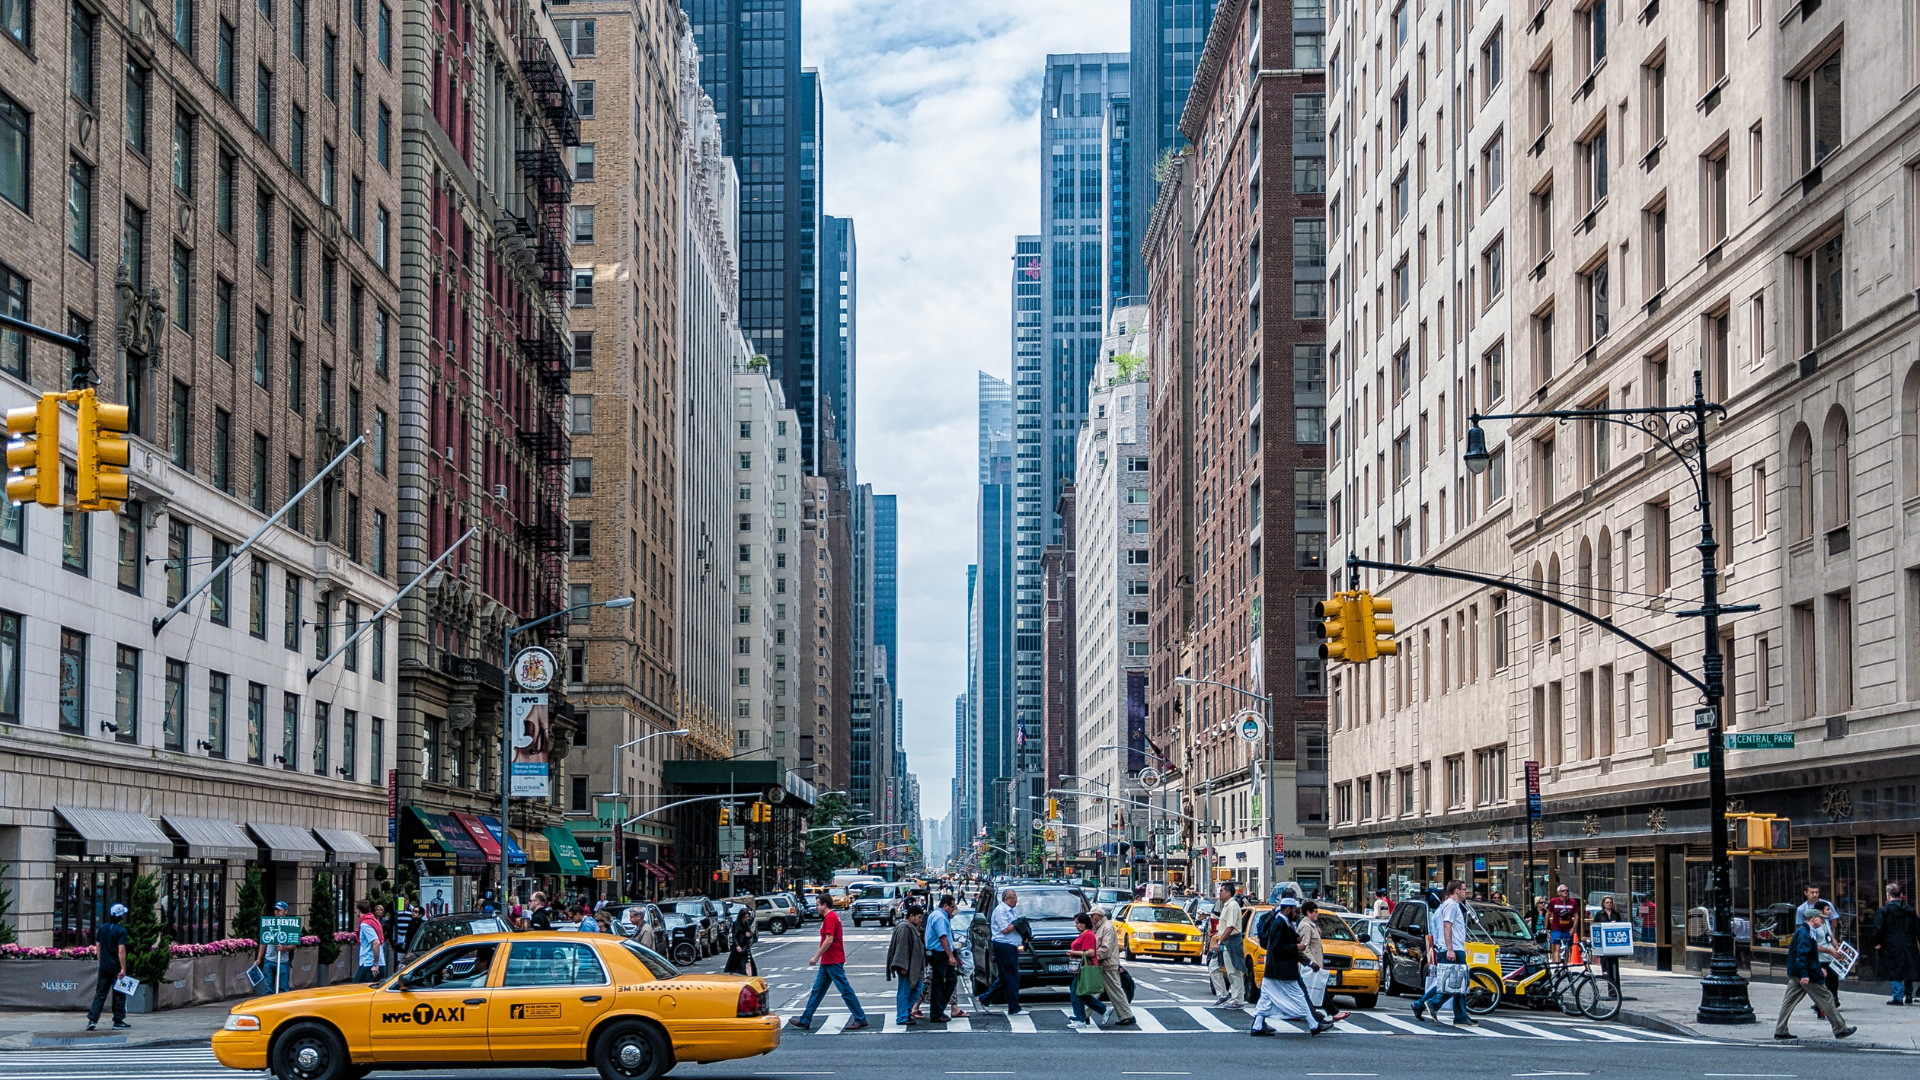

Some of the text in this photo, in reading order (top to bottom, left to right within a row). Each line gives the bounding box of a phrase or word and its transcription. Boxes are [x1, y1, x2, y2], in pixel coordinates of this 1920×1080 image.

[1737, 734, 1793, 744] CENTRAL PARK
[261, 918, 299, 927] BIKE RENTAL
[41, 981, 79, 990] MARKET
[382, 1003, 465, 1025] NYC TAXI
